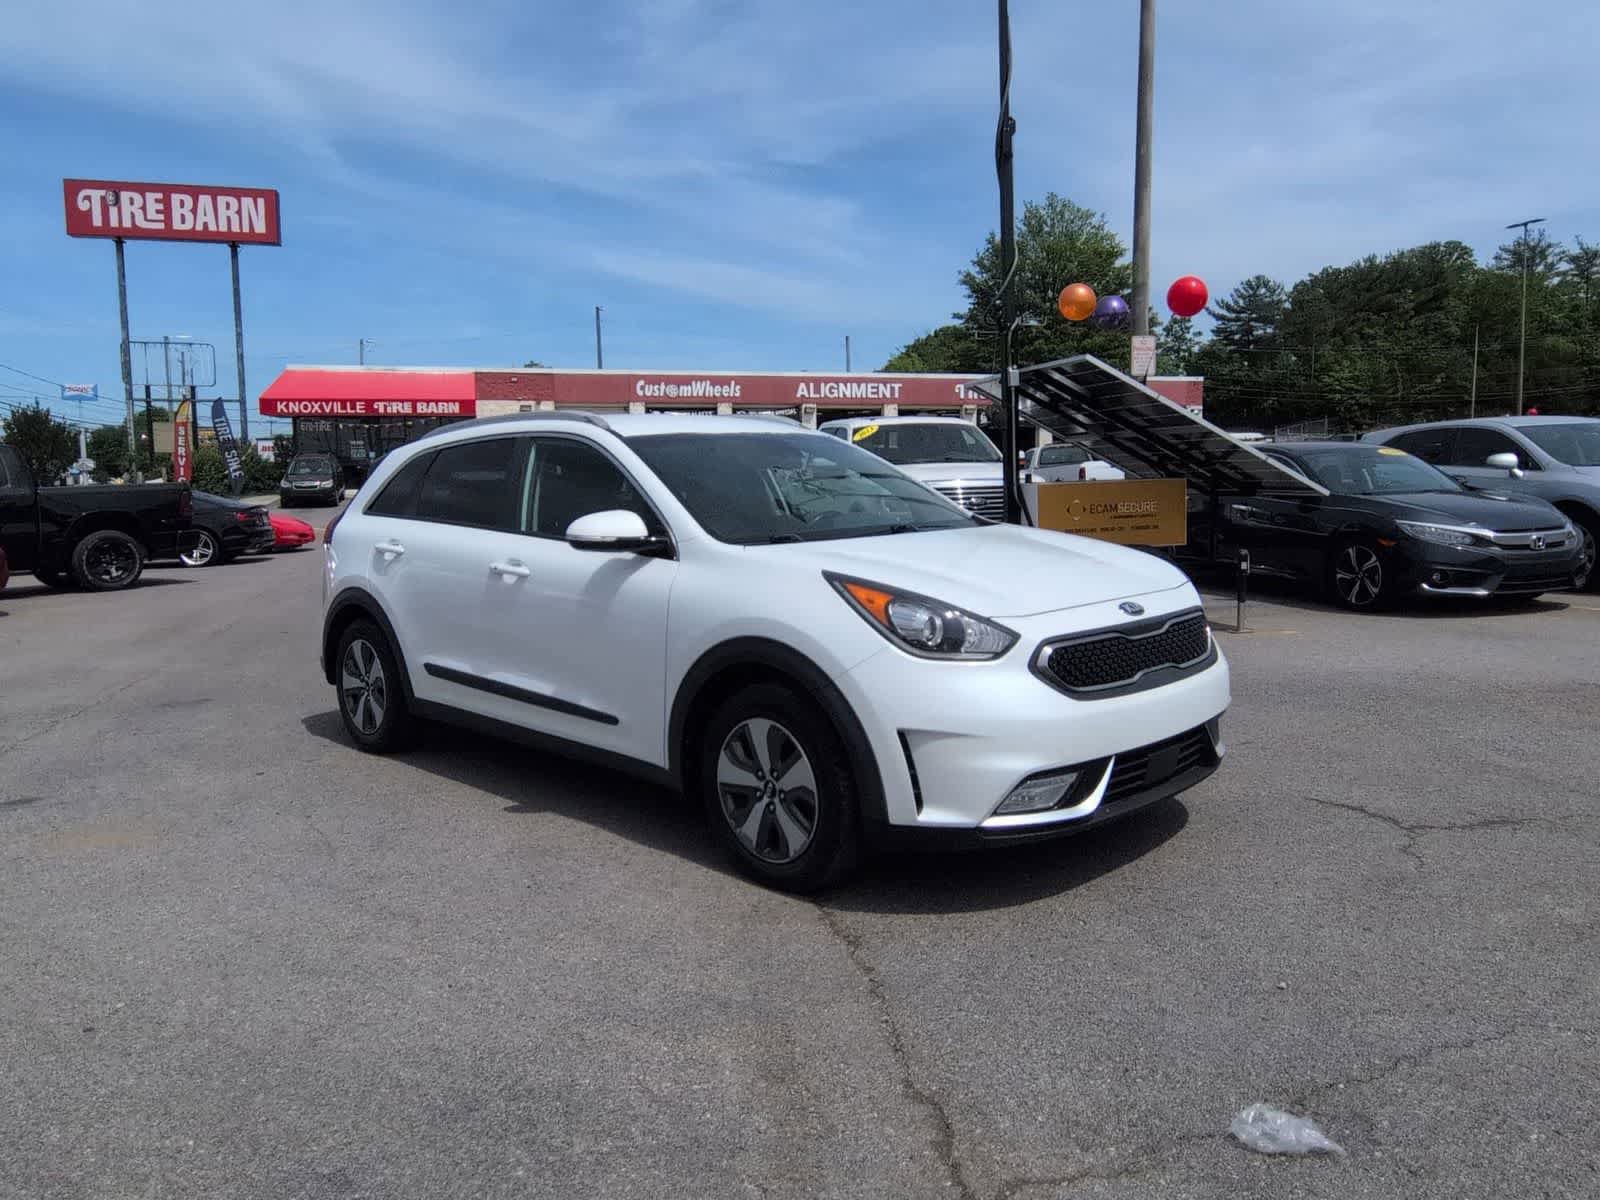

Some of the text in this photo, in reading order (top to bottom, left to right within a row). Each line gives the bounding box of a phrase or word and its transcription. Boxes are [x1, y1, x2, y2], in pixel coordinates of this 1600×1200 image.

[170, 192, 266, 234] BARN
[796, 382, 902, 399] ALIGNMENT
[277, 401, 366, 414] KNOXVILLE
[416, 402, 460, 414] BARN
